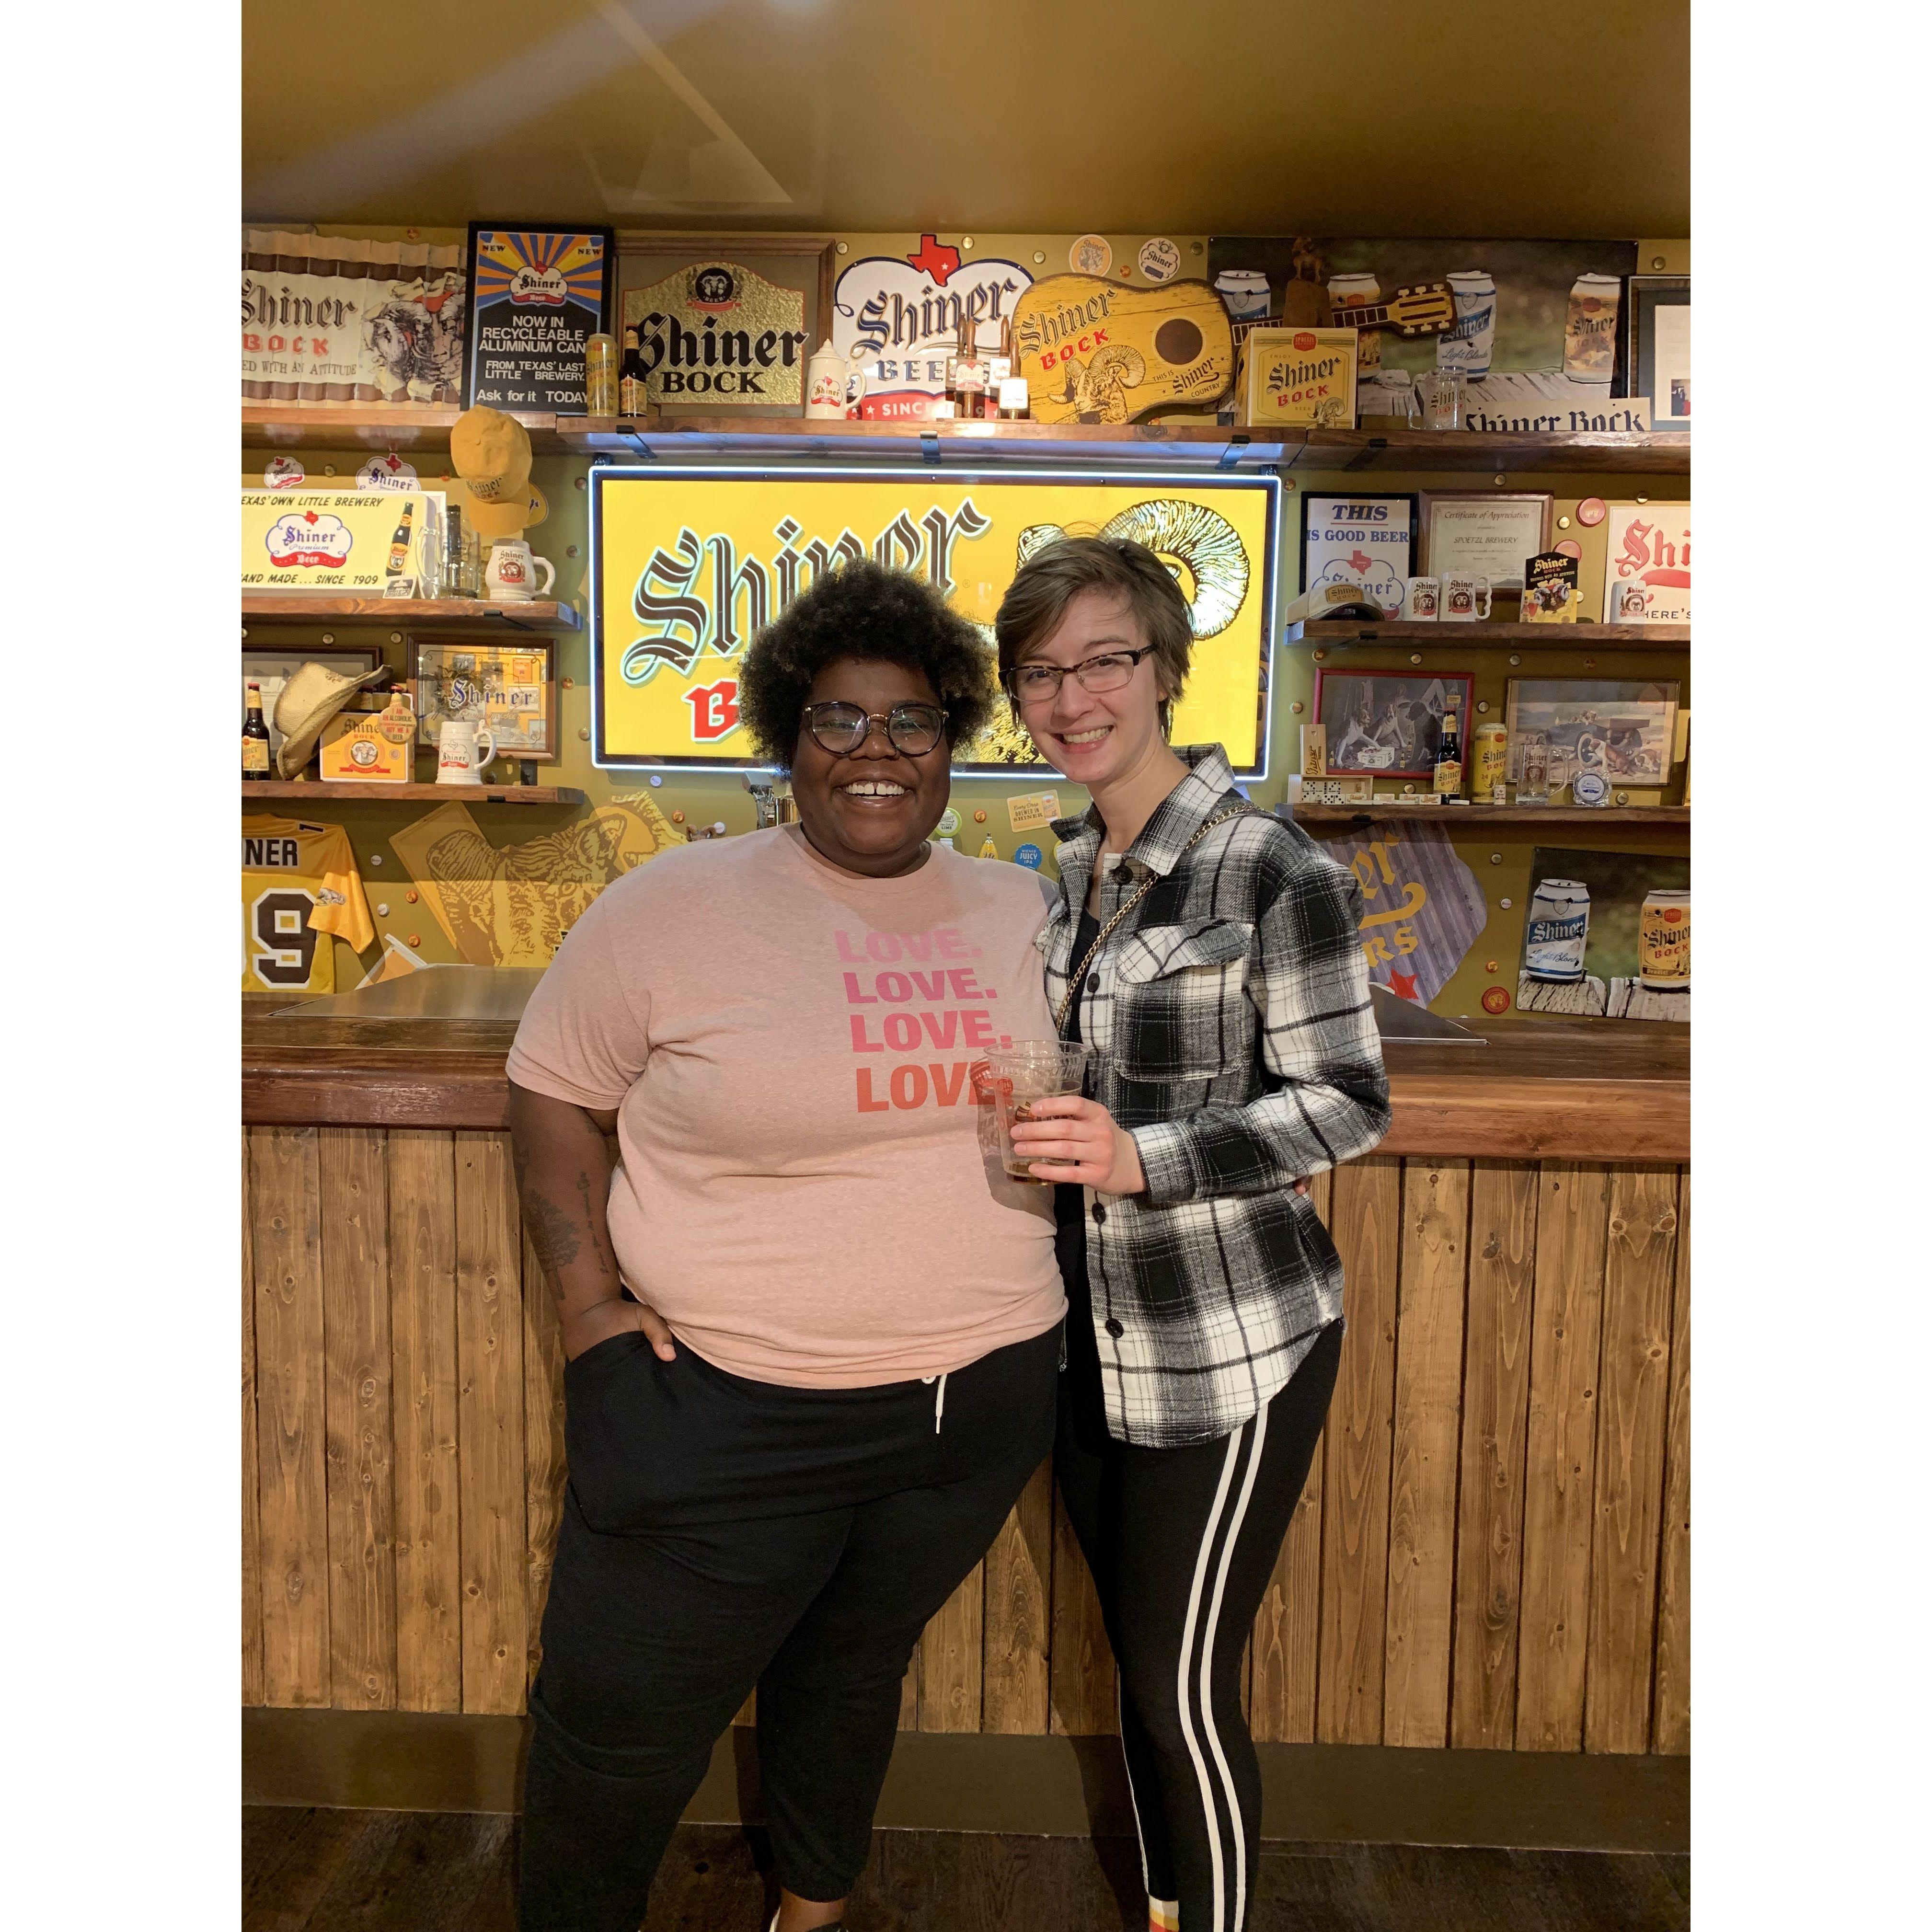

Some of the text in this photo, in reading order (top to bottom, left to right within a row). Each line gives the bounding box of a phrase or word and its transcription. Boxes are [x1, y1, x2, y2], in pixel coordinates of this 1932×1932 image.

[1083, 239, 1106, 252] Shiner
[1144, 250, 1173, 268] Shiner
[519, 274, 561, 290] Shiner
[242, 277, 357, 330] Shiner
[513, 315, 564, 328] NOW IN
[850, 276, 1018, 360] Shiner
[1019, 289, 1118, 360] Shiner
[483, 327, 584, 341] RECYCLEABLE
[1441, 314, 1488, 342] hiner
[242, 333, 329, 356] BOCK
[479, 340, 552, 353] ALUMINUM
[638, 311, 810, 375] Shiner
[1039, 327, 1110, 371] BOCK
[1442, 347, 1464, 363] Light
[262, 361, 288, 373] WITH
[291, 360, 304, 373] AN
[310, 361, 357, 376] ATTITUDE
[486, 361, 585, 372] FROM TEXAS' LAST
[876, 359, 990, 384] BEE
[485, 370, 585, 381] LITTLE BREWERY.
[660, 371, 766, 393] BOCK
[1152, 372, 1167, 382] THIS
[1173, 357, 1215, 396] Shiner
[1266, 356, 1341, 394] Shiner
[476, 389, 587, 403] Ask for it TODAY
[815, 385, 840, 396] Shiner
[1191, 382, 1220, 398] COUNTRY
[1277, 384, 1330, 407] BOCK
[882, 401, 933, 416] SINC
[1466, 413, 1562, 431] Shiner
[368, 467, 412, 491] Shiner
[271, 496, 294, 506] OWN
[298, 496, 331, 506] LITTLE
[334, 497, 384, 507] BREWERY
[1332, 505, 1388, 521] THIS
[1445, 511, 1530, 521] Certificate of Appreciation
[283, 525, 336, 546] Shiner
[1307, 529, 1409, 542] IS GOOD BEER
[297, 554, 319, 564] Beer
[499, 550, 524, 561] Shiner
[1533, 558, 1569, 574] Shiner
[242, 574, 264, 583] AND
[316, 575, 344, 584] SINCE
[353, 575, 379, 585] 1909
[1332, 572, 1392, 595] ner
[1414, 582, 1438, 593] Shiner
[1449, 580, 1473, 593] Shiner
[1331, 586, 1357, 597] Shiner
[1626, 586, 1644, 595] Shiner
[448, 676, 532, 710] Shiner
[341, 718, 380, 736] Shine
[443, 752, 466, 760] Shiner
[1438, 770, 1460, 782] Shiner
[1013, 813, 1043, 822] SHINER
[245, 839, 298, 866] NER
[1531, 920, 1584, 942] Shiner
[835, 929, 983, 964] LOVE.
[1655, 943, 1688, 958] BOCK
[1553, 952, 1580, 963] Blond
[843, 968, 998, 1003] LOVE.
[850, 1010, 1013, 1053] LOVE.
